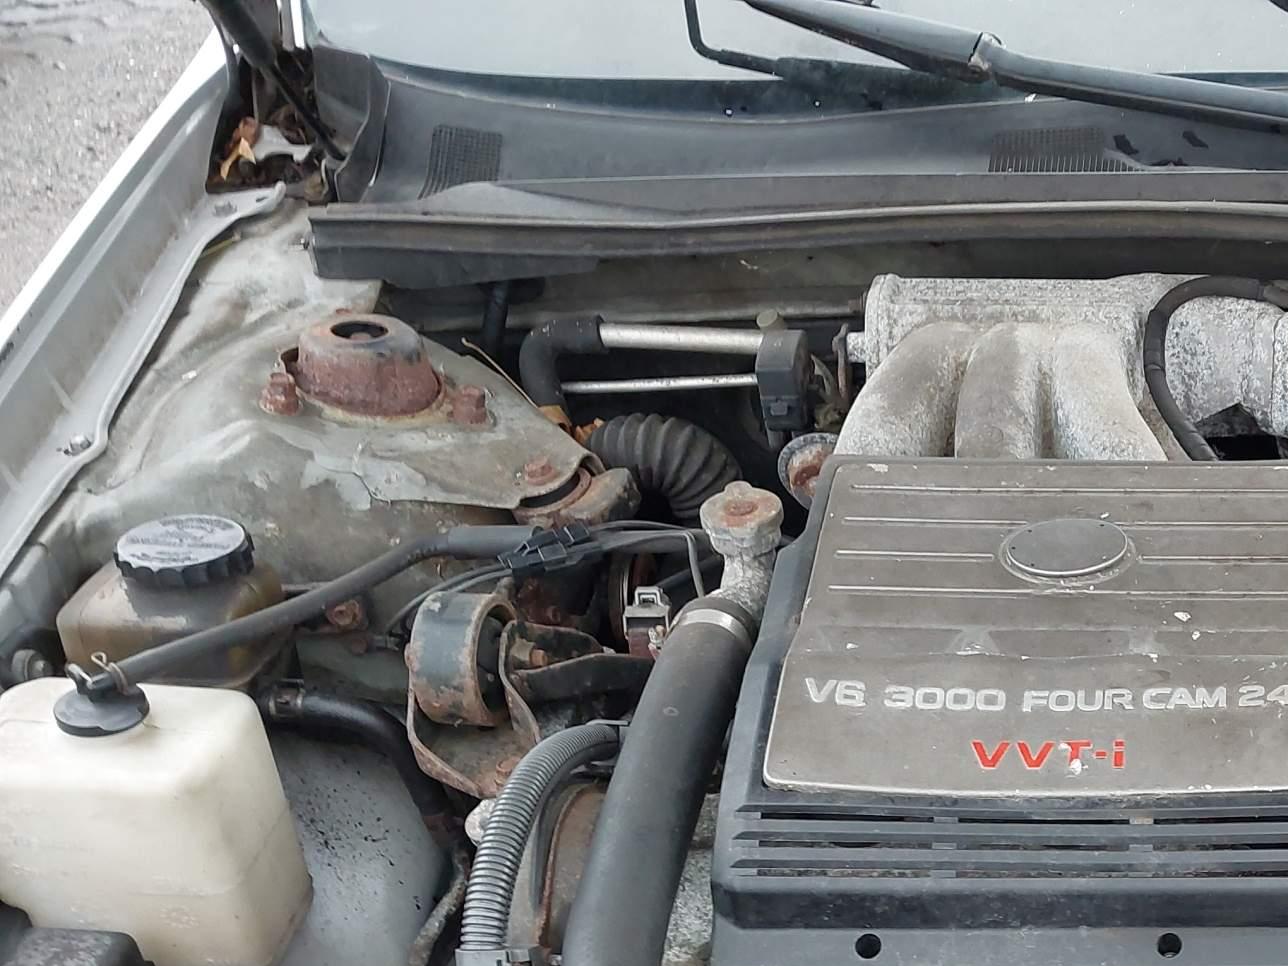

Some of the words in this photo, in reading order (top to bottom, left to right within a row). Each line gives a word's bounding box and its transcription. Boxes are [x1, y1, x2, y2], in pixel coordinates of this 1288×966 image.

[805, 677, 867, 708] V6
[883, 685, 1007, 711] 3000
[1022, 688, 1135, 713] FOUR
[1142, 685, 1228, 710] CAM
[970, 738, 1126, 771] VVT-i
